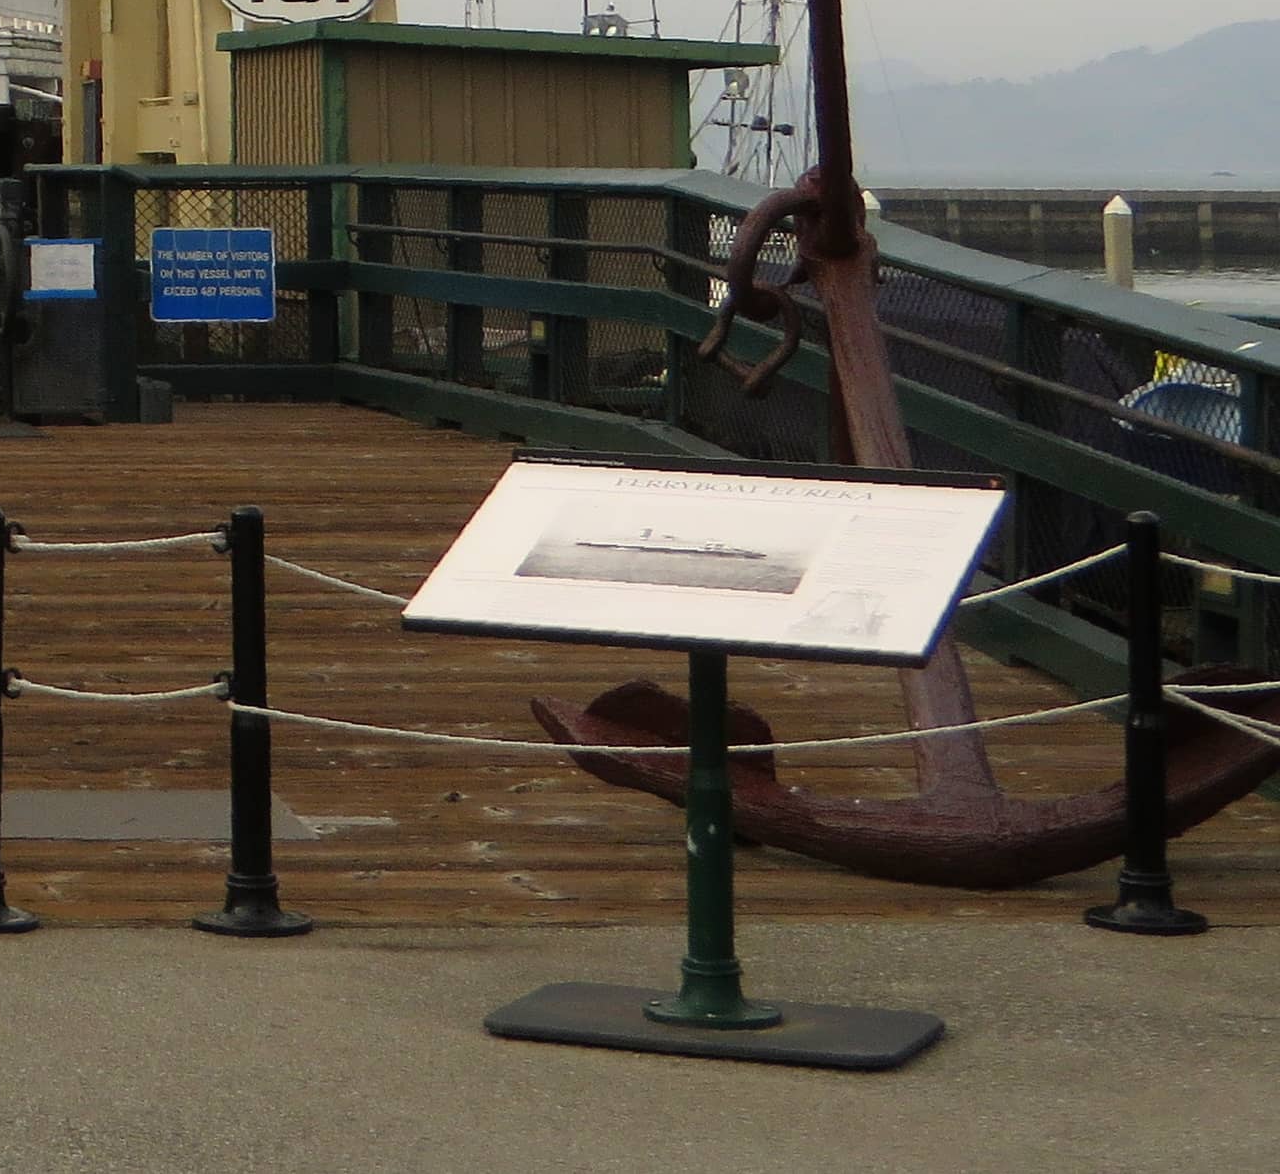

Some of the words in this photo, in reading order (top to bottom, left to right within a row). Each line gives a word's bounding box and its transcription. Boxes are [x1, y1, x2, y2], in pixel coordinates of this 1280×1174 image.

[157, 250, 175, 260] THE
[198, 269, 232, 280] VESSEL
[234, 269, 251, 280] NOT
[255, 270, 266, 280] TO
[613, 476, 758, 494] FERRYBOAT
[770, 486, 874, 501] EUREKA
